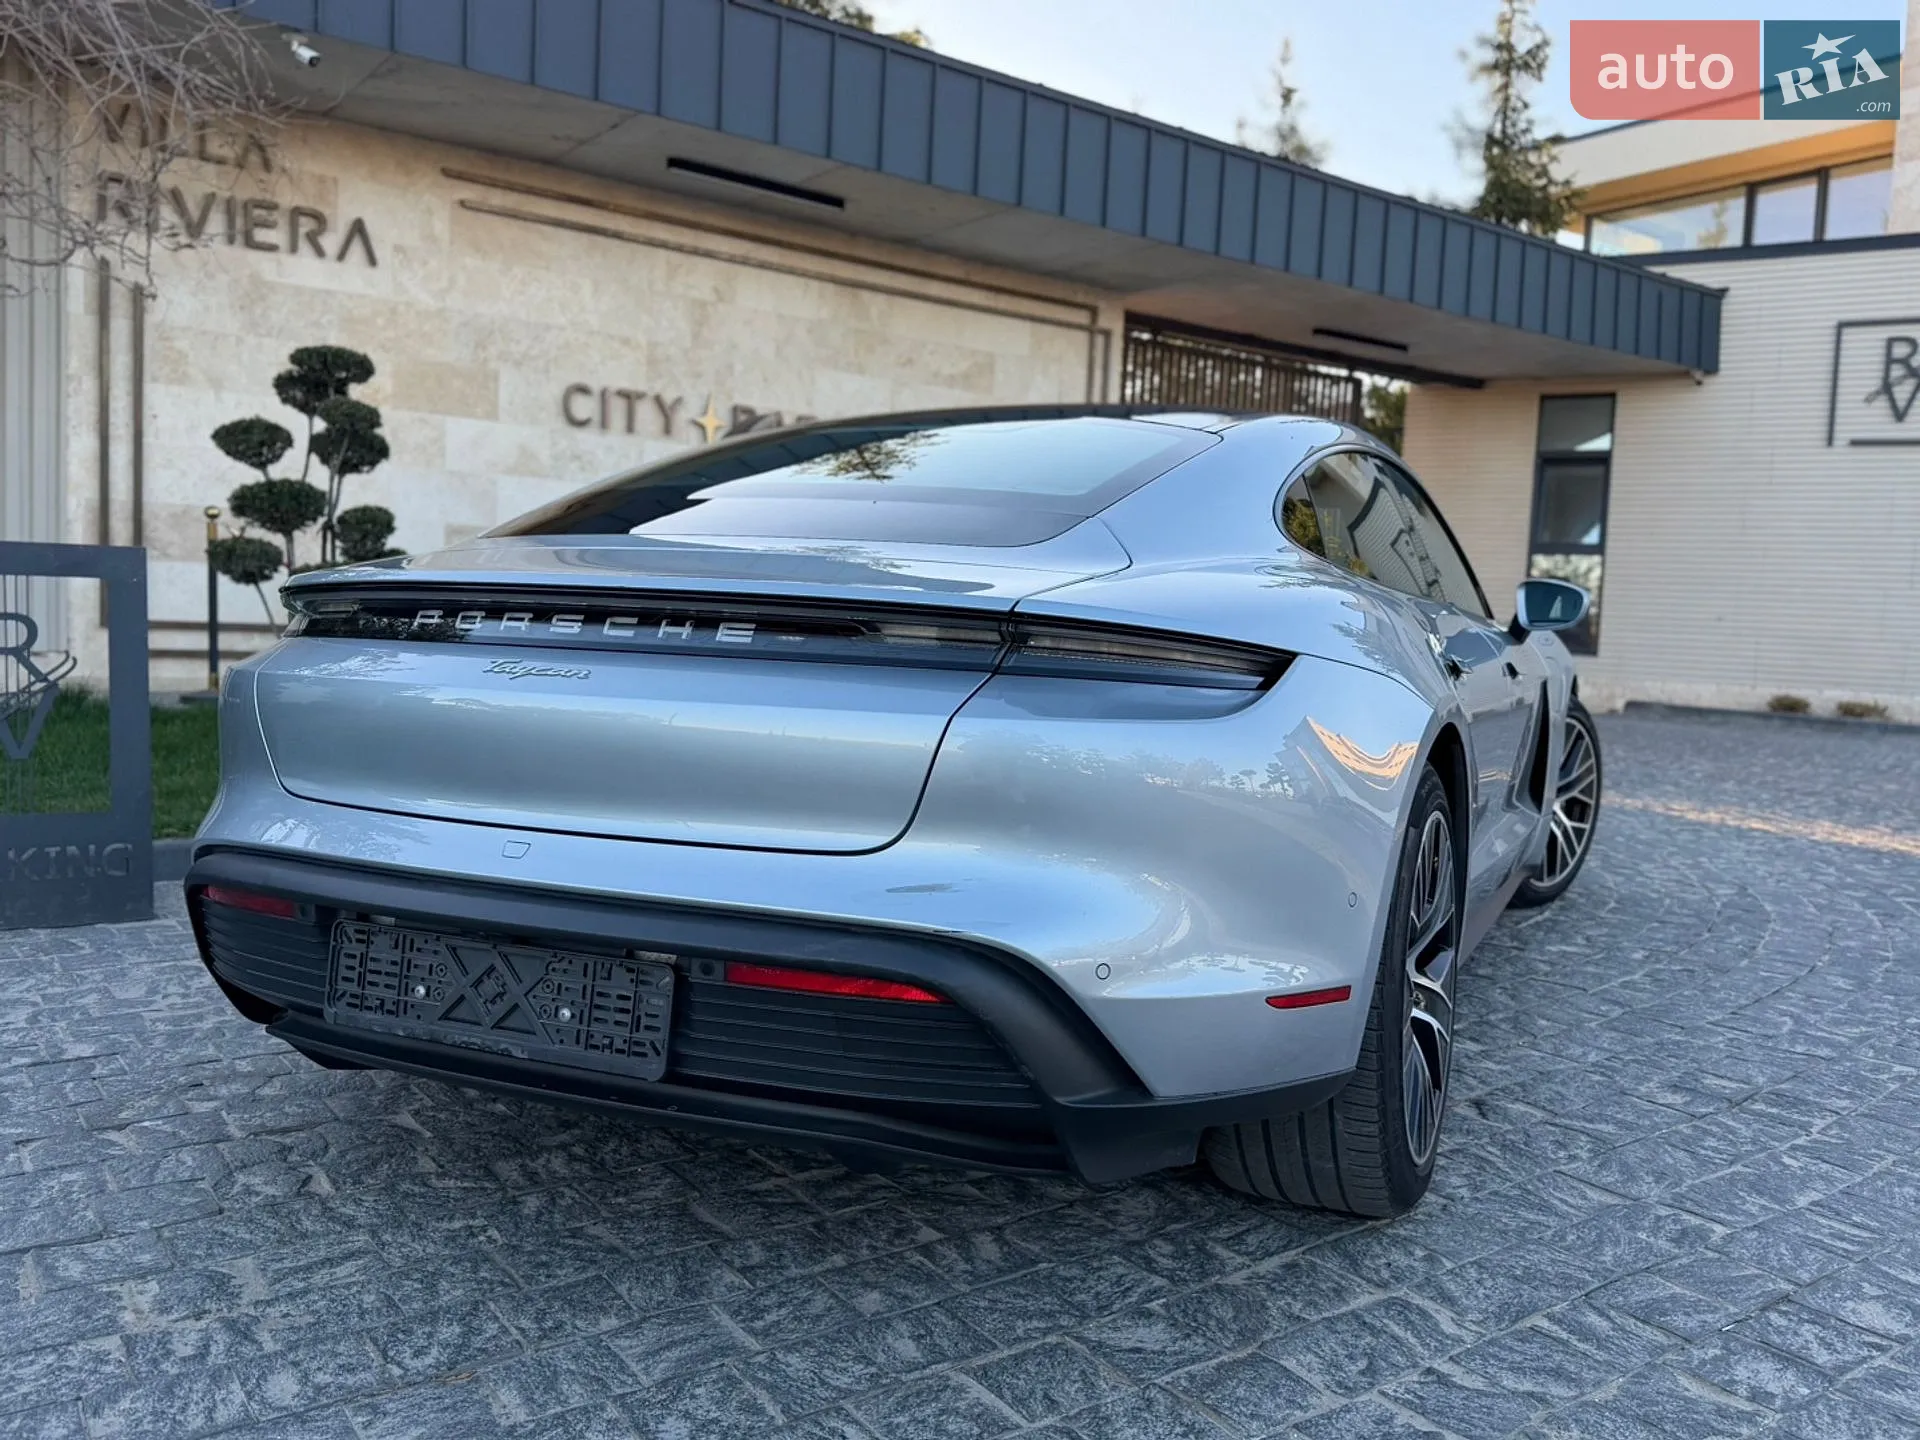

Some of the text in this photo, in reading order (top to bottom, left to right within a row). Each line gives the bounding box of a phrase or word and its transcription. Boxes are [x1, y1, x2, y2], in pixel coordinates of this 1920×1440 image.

[96, 168, 378, 268] RIVIERA
[561, 382, 684, 436] CITY
[411, 608, 758, 644] PORSCHE
[482, 658, 593, 681] Taycan
